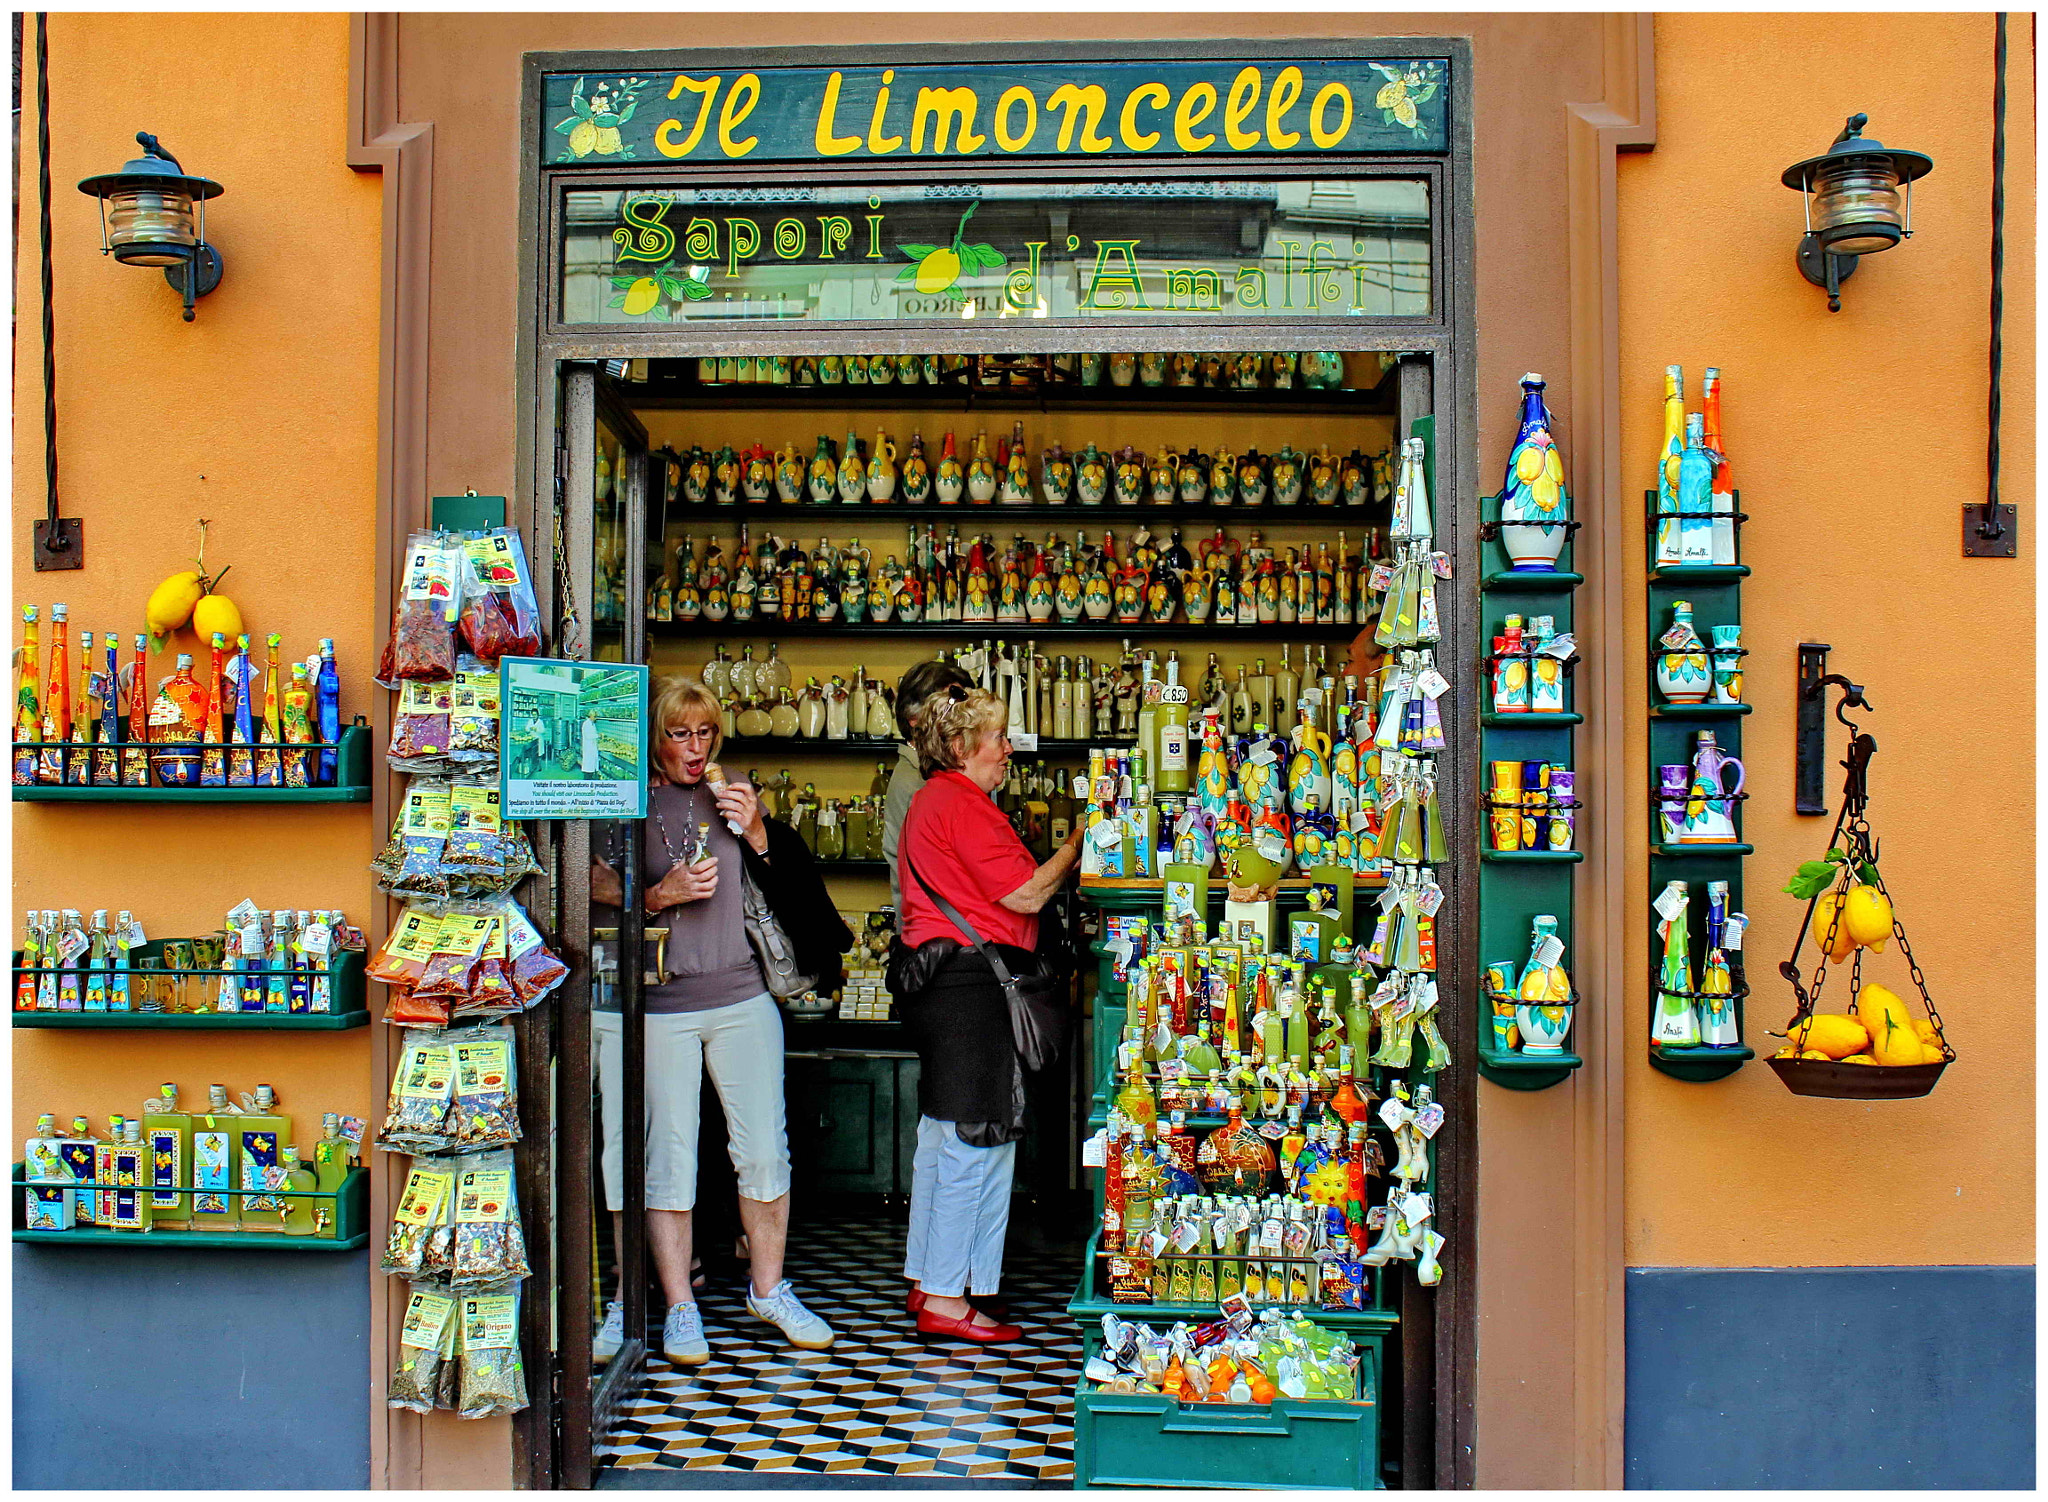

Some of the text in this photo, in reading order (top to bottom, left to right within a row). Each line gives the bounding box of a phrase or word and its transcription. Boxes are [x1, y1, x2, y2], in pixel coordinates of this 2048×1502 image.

[655, 65, 1354, 159] Il Limoncello
[612, 193, 886, 278] Sapori
[1002, 234, 1368, 312] d'Amalfi
[485, 1323, 512, 1332] Origano
